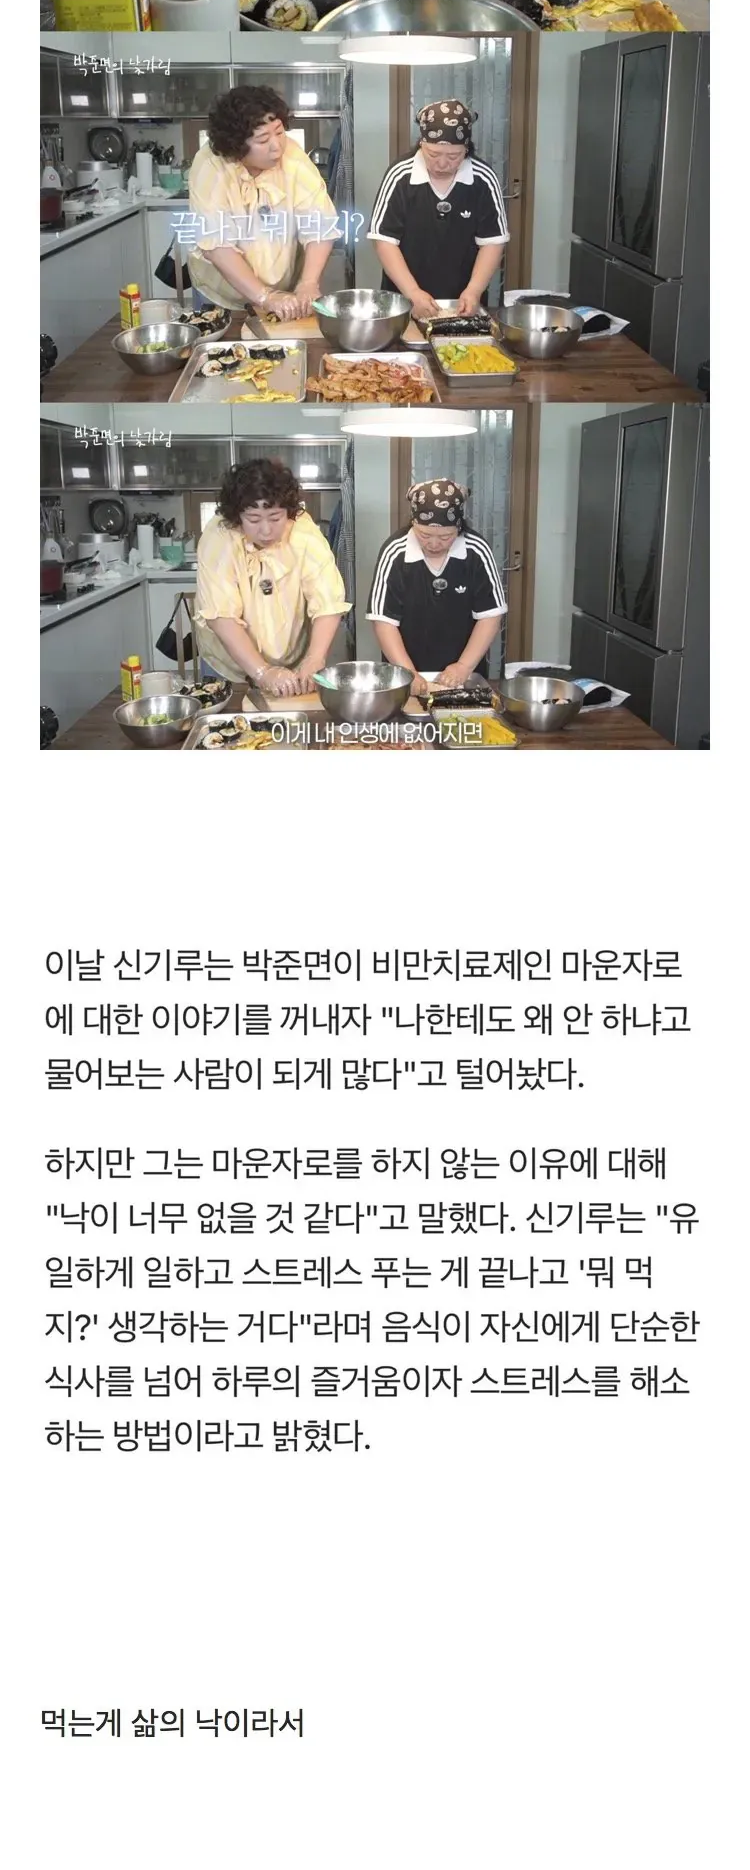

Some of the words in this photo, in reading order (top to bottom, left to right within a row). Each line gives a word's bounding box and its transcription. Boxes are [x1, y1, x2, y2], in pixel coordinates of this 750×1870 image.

[45, 948, 105, 982] 이날
[113, 948, 234, 982] 신기루는
[243, 948, 361, 982] 박준면이
[373, 948, 552, 982] 비만치료제인
[562, 948, 683, 982] 마운자로
[45, 1003, 73, 1036] 에
[83, 1003, 144, 1036] 대한
[152, 1003, 273, 1036] 이야기를
[279, 1003, 372, 1036] 꺼내자
[382, 1003, 516, 1036] "나한테도
[523, 1003, 552, 1036] 왜
[563, 1003, 593, 1035] 안
[600, 1003, 691, 1036] 하냐고
[44, 1057, 165, 1091] 물어보는
[173, 1057, 262, 1091] 사람이
[272, 1057, 331, 1091] 되게
[342, 1057, 447, 1091] 많다"고
[456, 1057, 584, 1091] 털어놨다.
[44, 1146, 135, 1180] 하지만
[142, 1148, 204, 1179] 그는
[212, 1147, 363, 1180] 마운자로를
[371, 1146, 429, 1180] 하지
[440, 1147, 500, 1180] 않는
[509, 1146, 598, 1180] 이유에
[608, 1146, 666, 1180] 대해
[46, 1201, 117, 1235] "낙이
[129, 1201, 188, 1235] 너무
[197, 1201, 257, 1234] 없을
[265, 1201, 294, 1234] 것
[303, 1201, 409, 1235] 같다"고
[418, 1201, 516, 1235] 말했다.
[526, 1201, 646, 1235] 신기루는
[656, 1202, 700, 1235] "유
[45, 1255, 133, 1289] 일하게
[143, 1255, 234, 1289] 일하고
[242, 1256, 363, 1289] 스트레스
[371, 1257, 432, 1289] 푸는
[440, 1255, 468, 1289] 게
[478, 1256, 569, 1289] 끝나고
[579, 1255, 614, 1289] '뭐
[625, 1255, 652, 1289] 먹
[45, 1310, 98, 1344] 지?'
[108, 1310, 229, 1344] 생각하는
[237, 1310, 371, 1344] 거다"라며
[381, 1310, 470, 1344] 음식이
[480, 1310, 599, 1344] 자신에게
[611, 1310, 701, 1343] 단순한
[44, 1364, 135, 1398] 식사를
[144, 1364, 201, 1398] 넘어
[211, 1364, 300, 1398] 하루의
[310, 1364, 463, 1398] 즐거움이자
[470, 1364, 621, 1398] 스트레스를
[629, 1364, 690, 1398] 해소
[44, 1419, 105, 1453] 하는
[113, 1419, 264, 1453] 방법이라고
[273, 1419, 371, 1453] 밝혔다.
[41, 1708, 121, 1738] 먹는게
[131, 1708, 184, 1738] 삶의
[196, 1708, 303, 1738] 낙이라서
